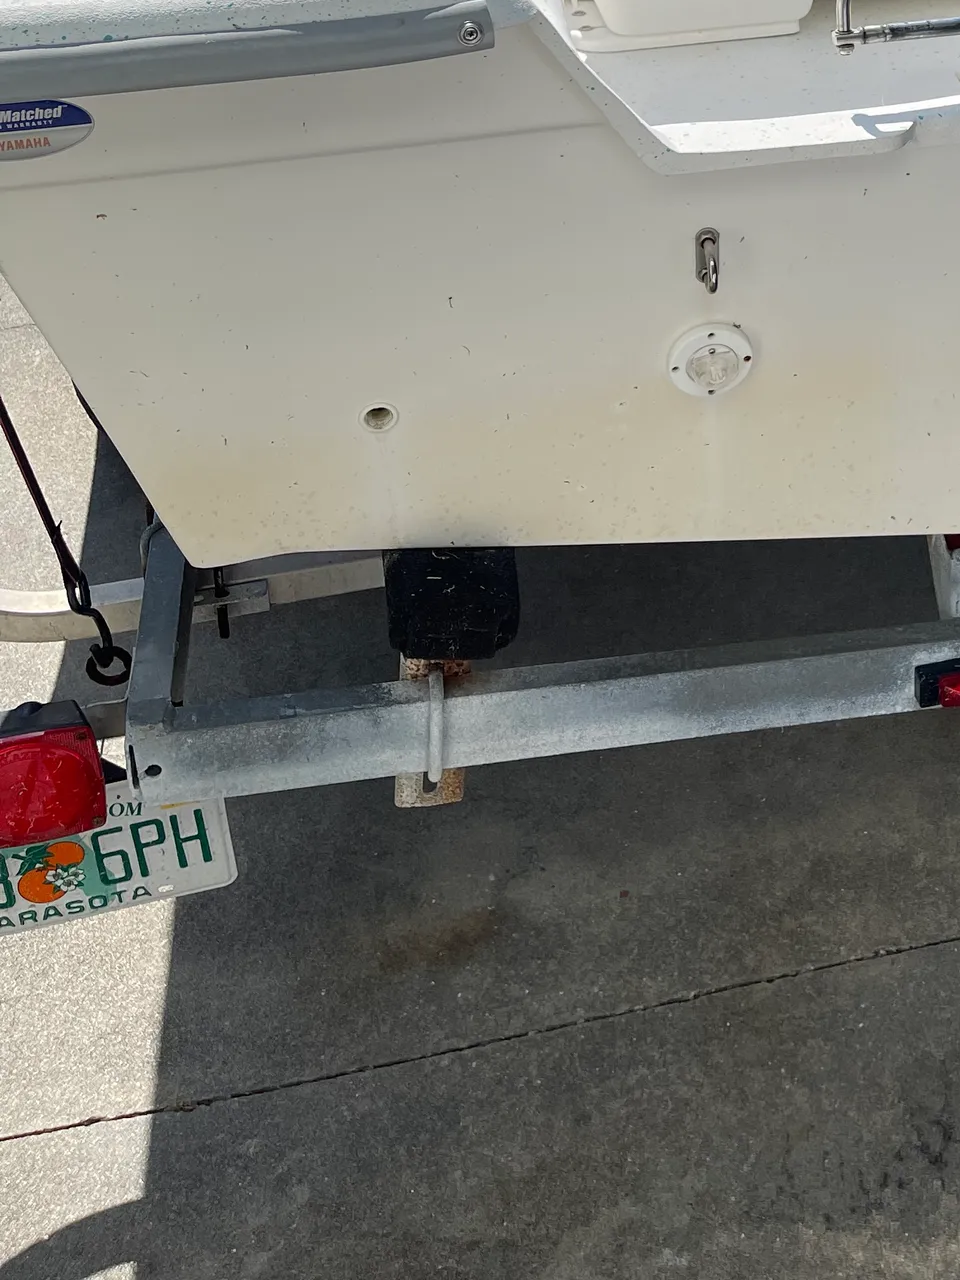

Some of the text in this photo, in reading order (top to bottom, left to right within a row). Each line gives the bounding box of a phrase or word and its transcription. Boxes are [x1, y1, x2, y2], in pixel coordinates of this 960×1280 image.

[0, 105, 63, 123] Matched
[0, 136, 52, 152] YAMAHA
[106, 801, 143, 817] OM
[90, 808, 213, 886] 6PH
[0, 885, 153, 929] ARASOTA
